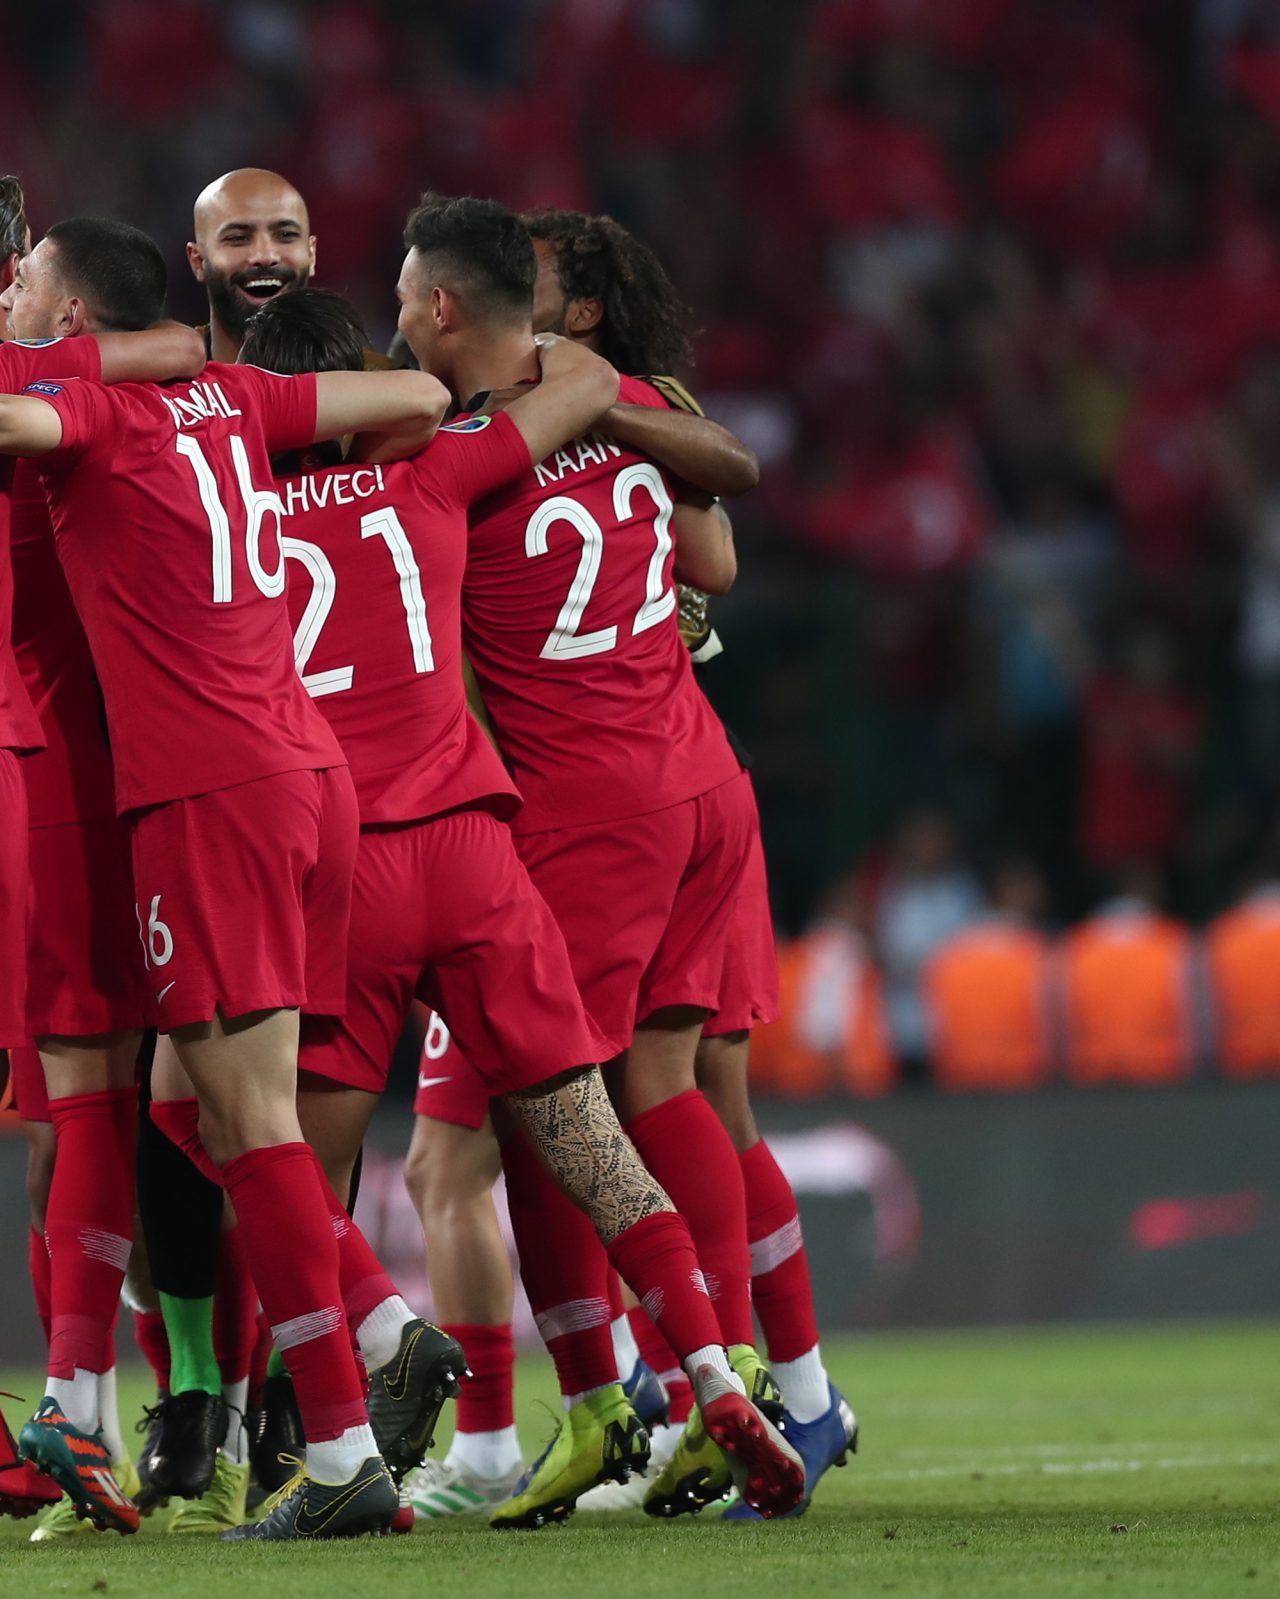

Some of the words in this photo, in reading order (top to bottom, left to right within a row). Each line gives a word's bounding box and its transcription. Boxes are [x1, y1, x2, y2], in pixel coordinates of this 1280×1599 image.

[176, 433, 286, 603] 16
[279, 464, 385, 516] HVECİ
[525, 462, 676, 660] 22
[282, 506, 434, 698] 21
[136, 895, 173, 970] 6
